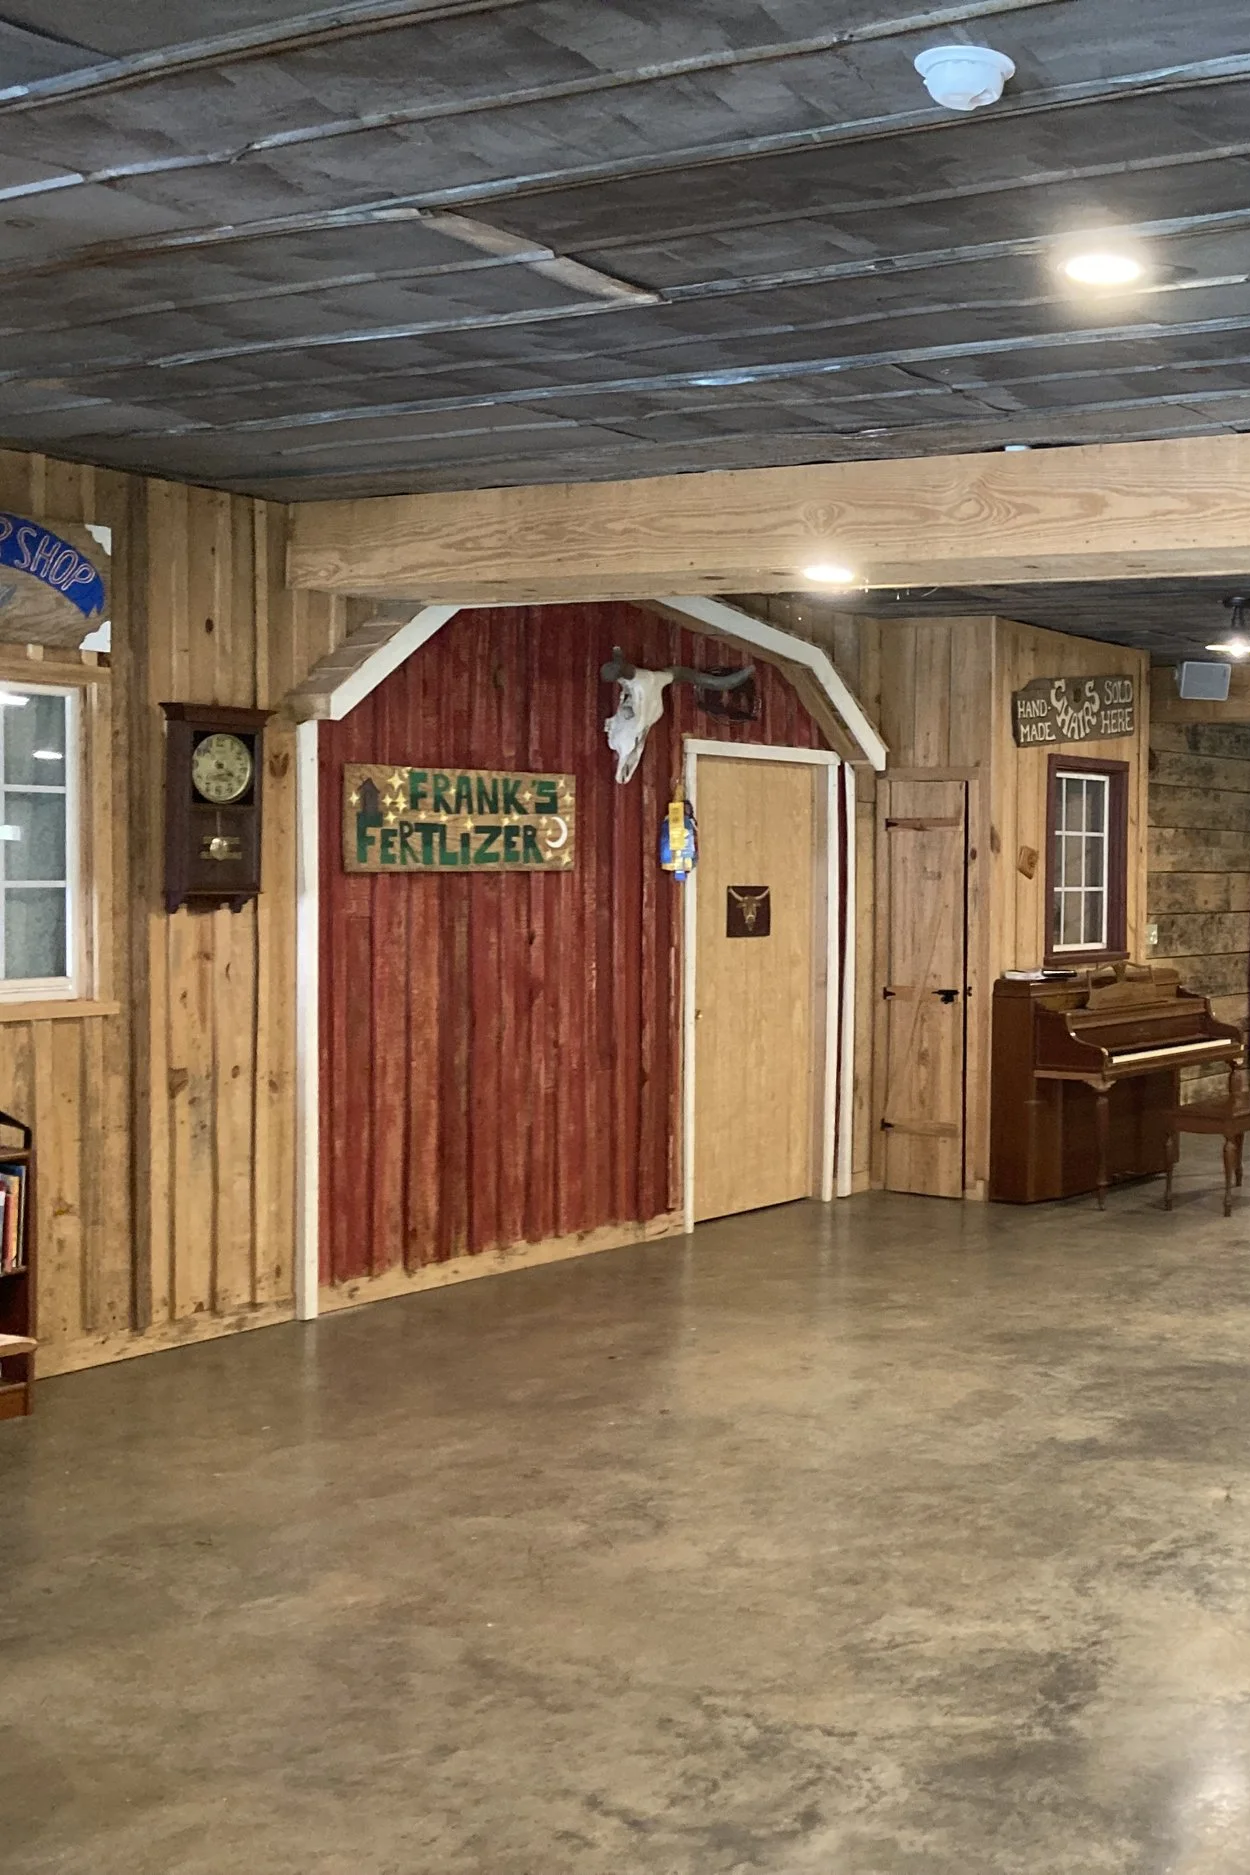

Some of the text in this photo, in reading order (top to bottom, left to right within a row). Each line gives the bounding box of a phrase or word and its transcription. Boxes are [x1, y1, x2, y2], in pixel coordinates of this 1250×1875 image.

[14, 527, 95, 591] SHOP
[1050, 679, 1100, 739] CHAIRS
[1104, 680, 1133, 705] SOLD
[1020, 722, 1056, 742] MADE
[1100, 708, 1134, 734] HERE
[408, 771, 558, 815] FRANK'S
[356, 812, 544, 866] FERTLIZER
